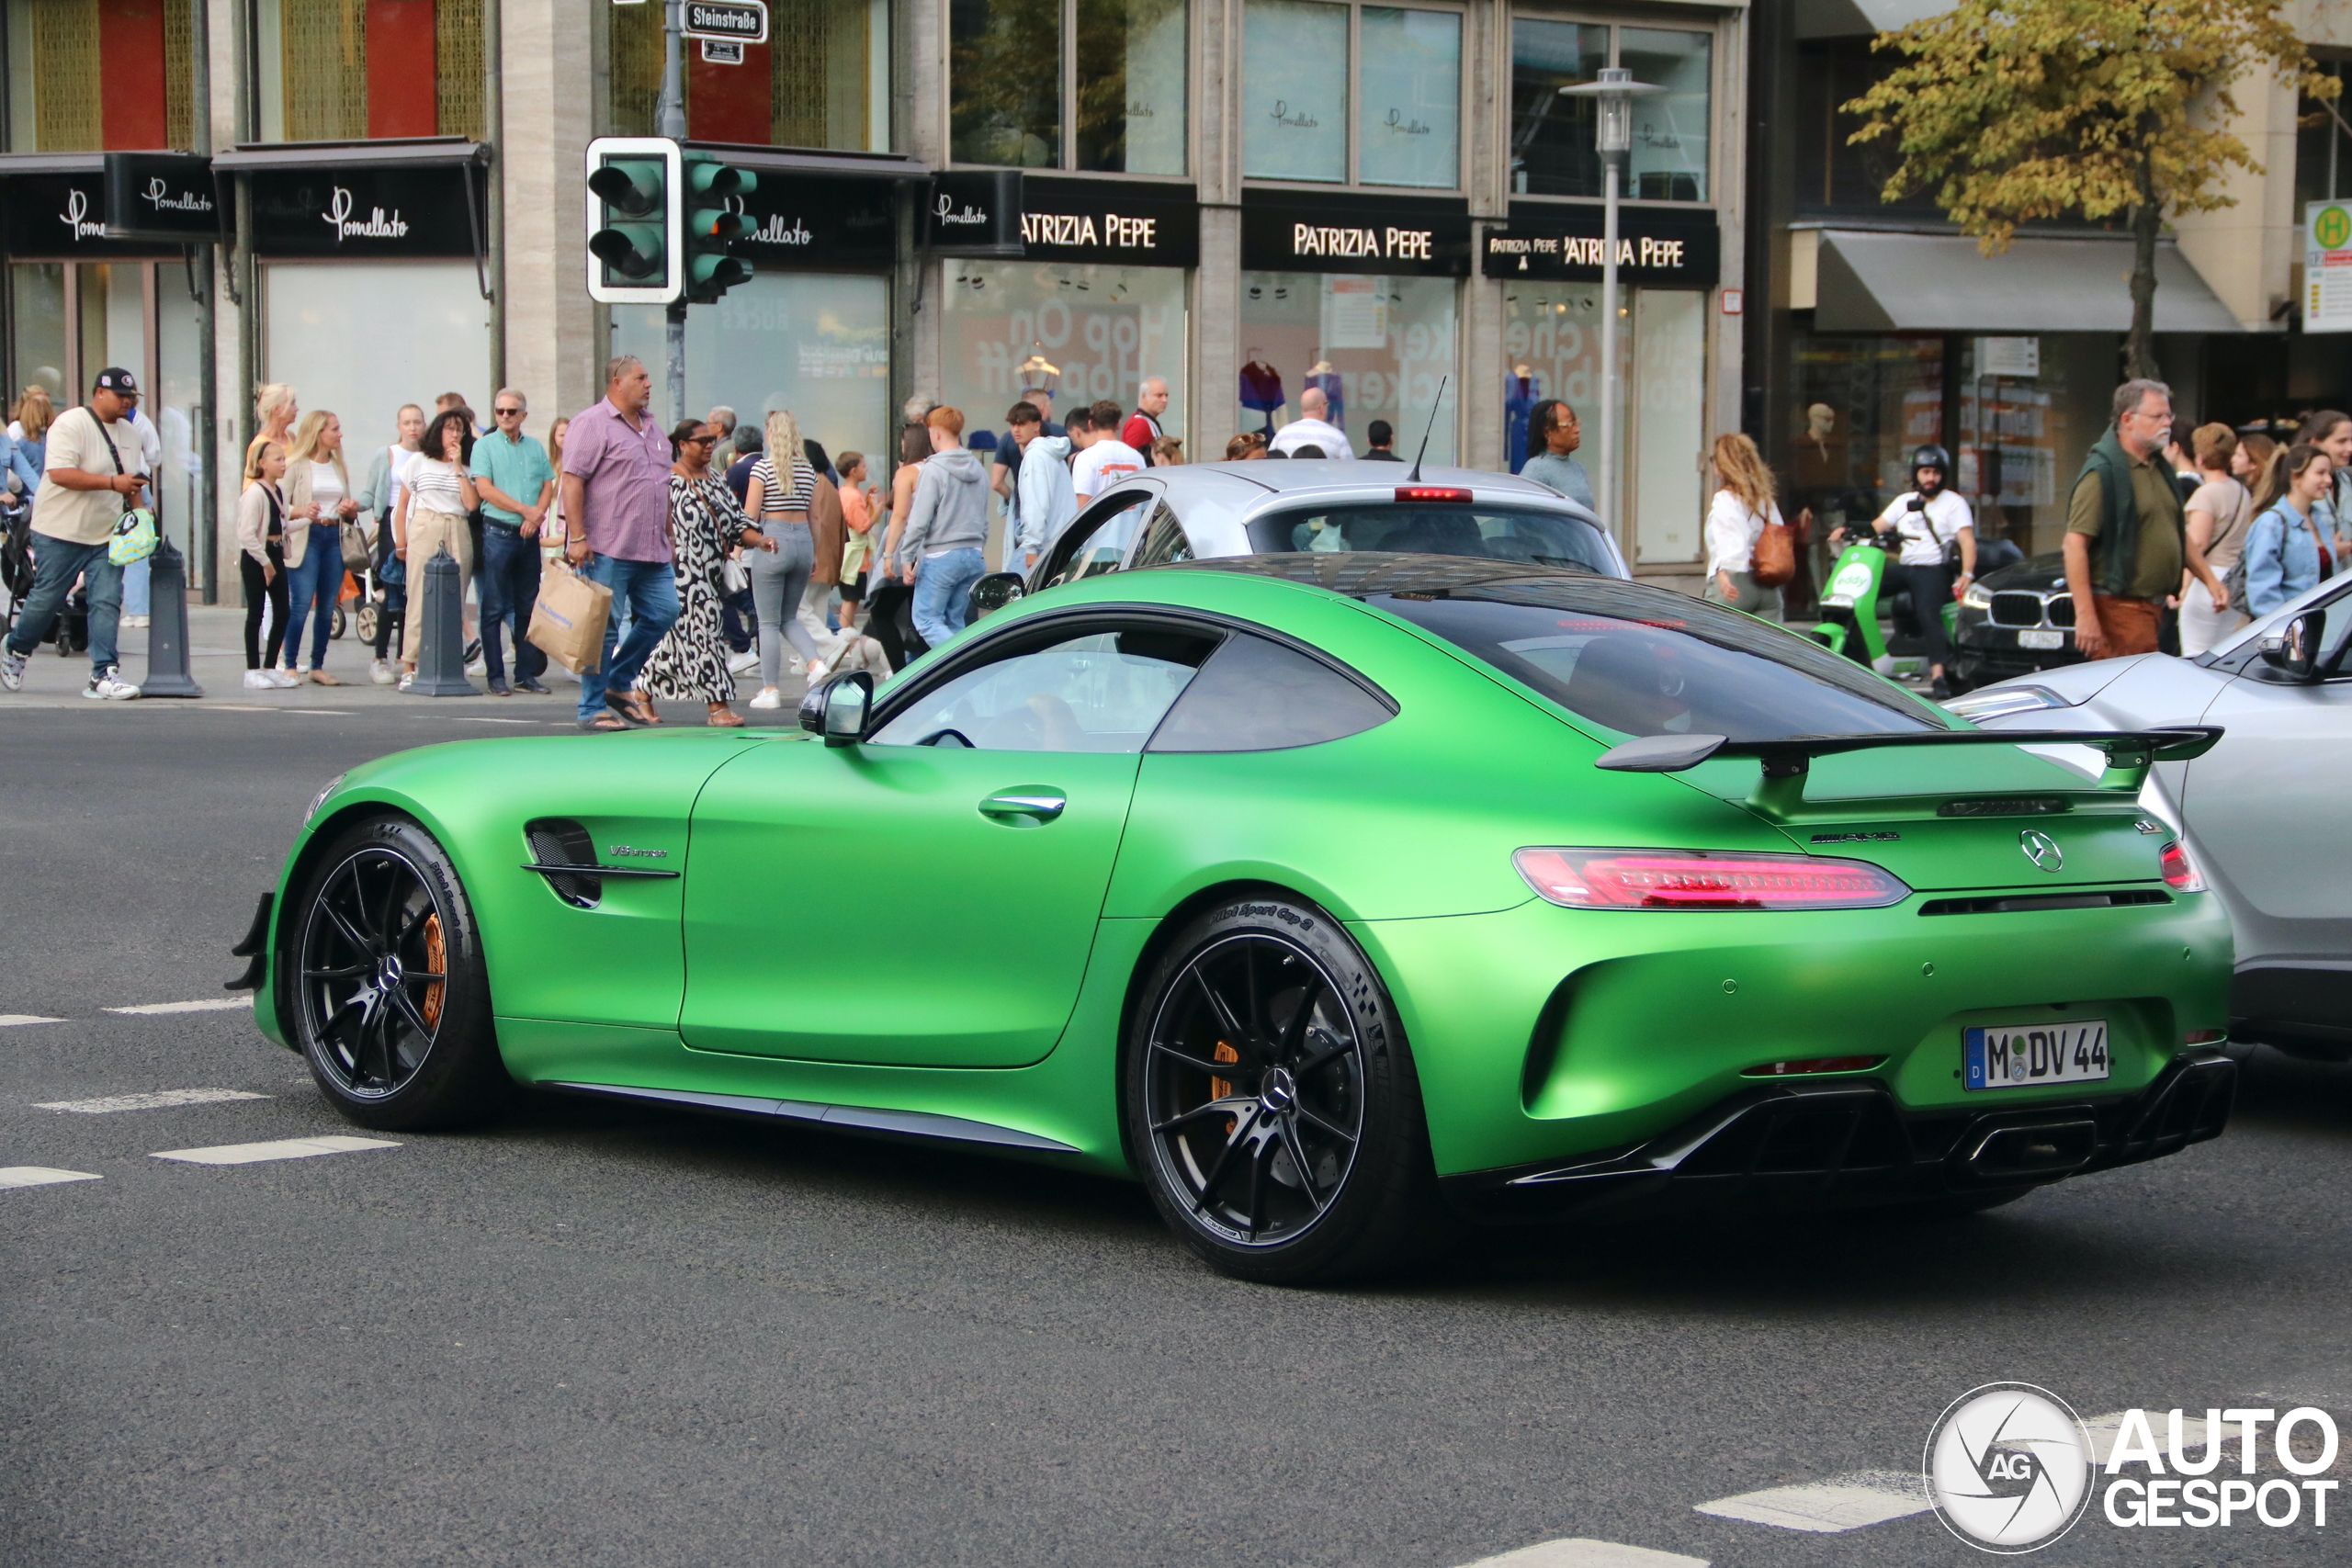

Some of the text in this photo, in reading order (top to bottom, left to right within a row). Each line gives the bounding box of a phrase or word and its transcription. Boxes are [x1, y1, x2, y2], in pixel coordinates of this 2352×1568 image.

[694, 6, 756, 29] Steinstraße
[1270, 99, 1318, 128] Pomellato
[1384, 107, 1430, 135] Pomellato
[141, 176, 213, 210] Pomellato
[60, 187, 105, 242] Pome
[322, 186, 409, 242] Pomellato
[932, 193, 988, 226] Pomellato
[1021, 212, 1157, 248] ATRIZIA PEPE
[1294, 222, 1432, 260] PATRIZIA PEPE
[1489, 237, 1559, 254] PATRIZIA PEPE
[1564, 236, 1684, 267] ATRIIA PEPE
[1838, 575, 1867, 588] eddy
[610, 845, 630, 856] V8
[1840, 831, 1901, 843] AMG
[430, 861, 449, 889] Pilot
[443, 889, 461, 927] Sport
[1209, 903, 1315, 931] Pilot Sport Cup 2
[1987, 1027, 2107, 1080] M DV 44
[1972, 1066, 1980, 1078] D
